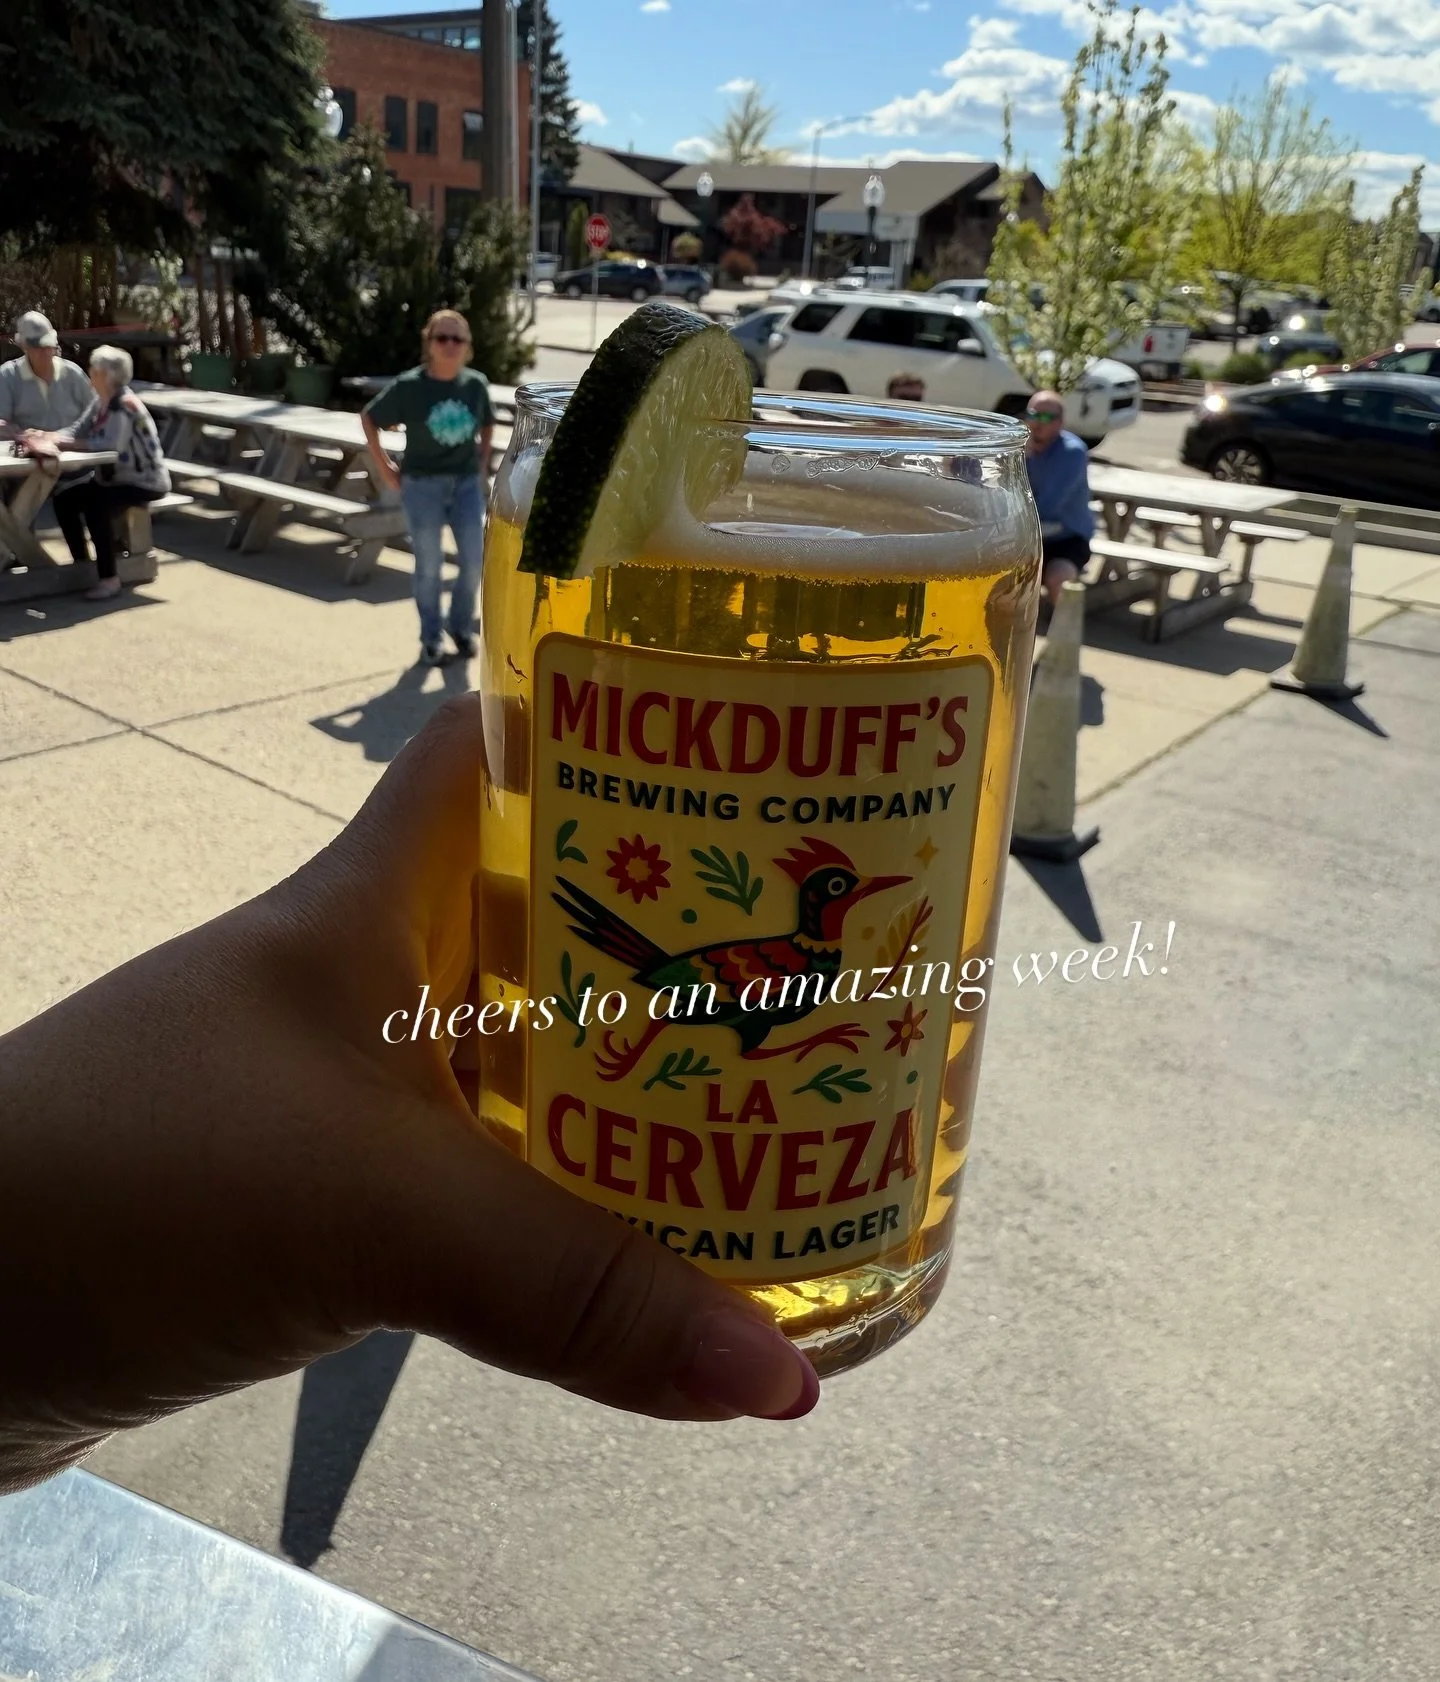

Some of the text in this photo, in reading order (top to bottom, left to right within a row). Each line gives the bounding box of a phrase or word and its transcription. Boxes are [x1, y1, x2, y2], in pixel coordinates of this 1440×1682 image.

[551, 672, 969, 778] MICKDUFF'S
[557, 761, 956, 825] BREWING COMPANY
[706, 1079, 779, 1125] LA
[547, 1093, 917, 1212] CERVEZA
[772, 1203, 901, 1261] LAGER
